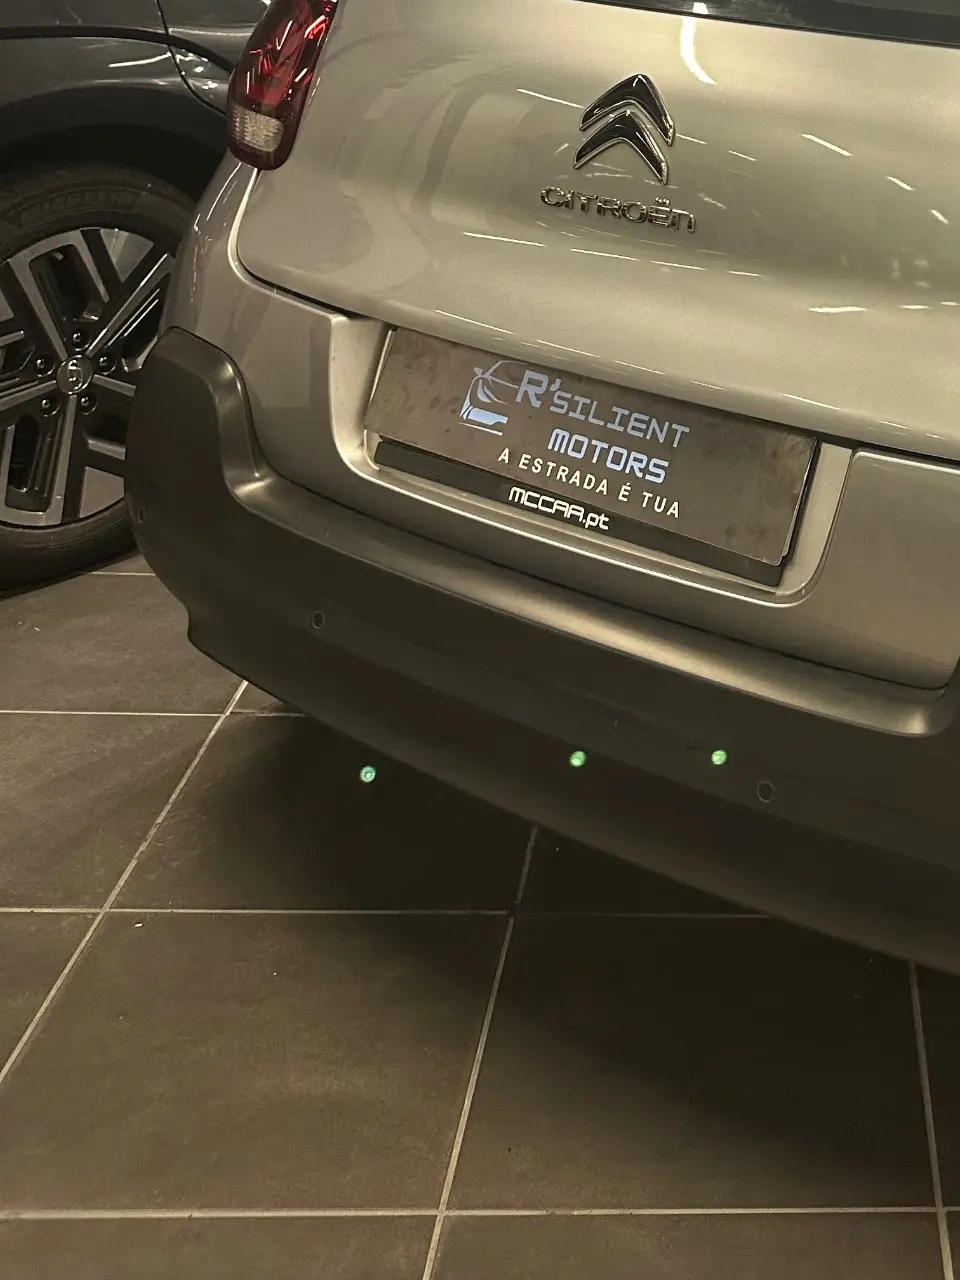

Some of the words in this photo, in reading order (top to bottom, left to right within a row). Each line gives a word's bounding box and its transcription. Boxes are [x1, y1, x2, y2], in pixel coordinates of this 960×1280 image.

[540, 185, 697, 234] CITROËN
[515, 369, 691, 449] R'SILIENT
[498, 448, 510, 464] A
[519, 453, 609, 496] ESTRADA
[618, 483, 632, 503] É
[641, 490, 681, 519] TUA
[548, 428, 670, 485] MOTORS
